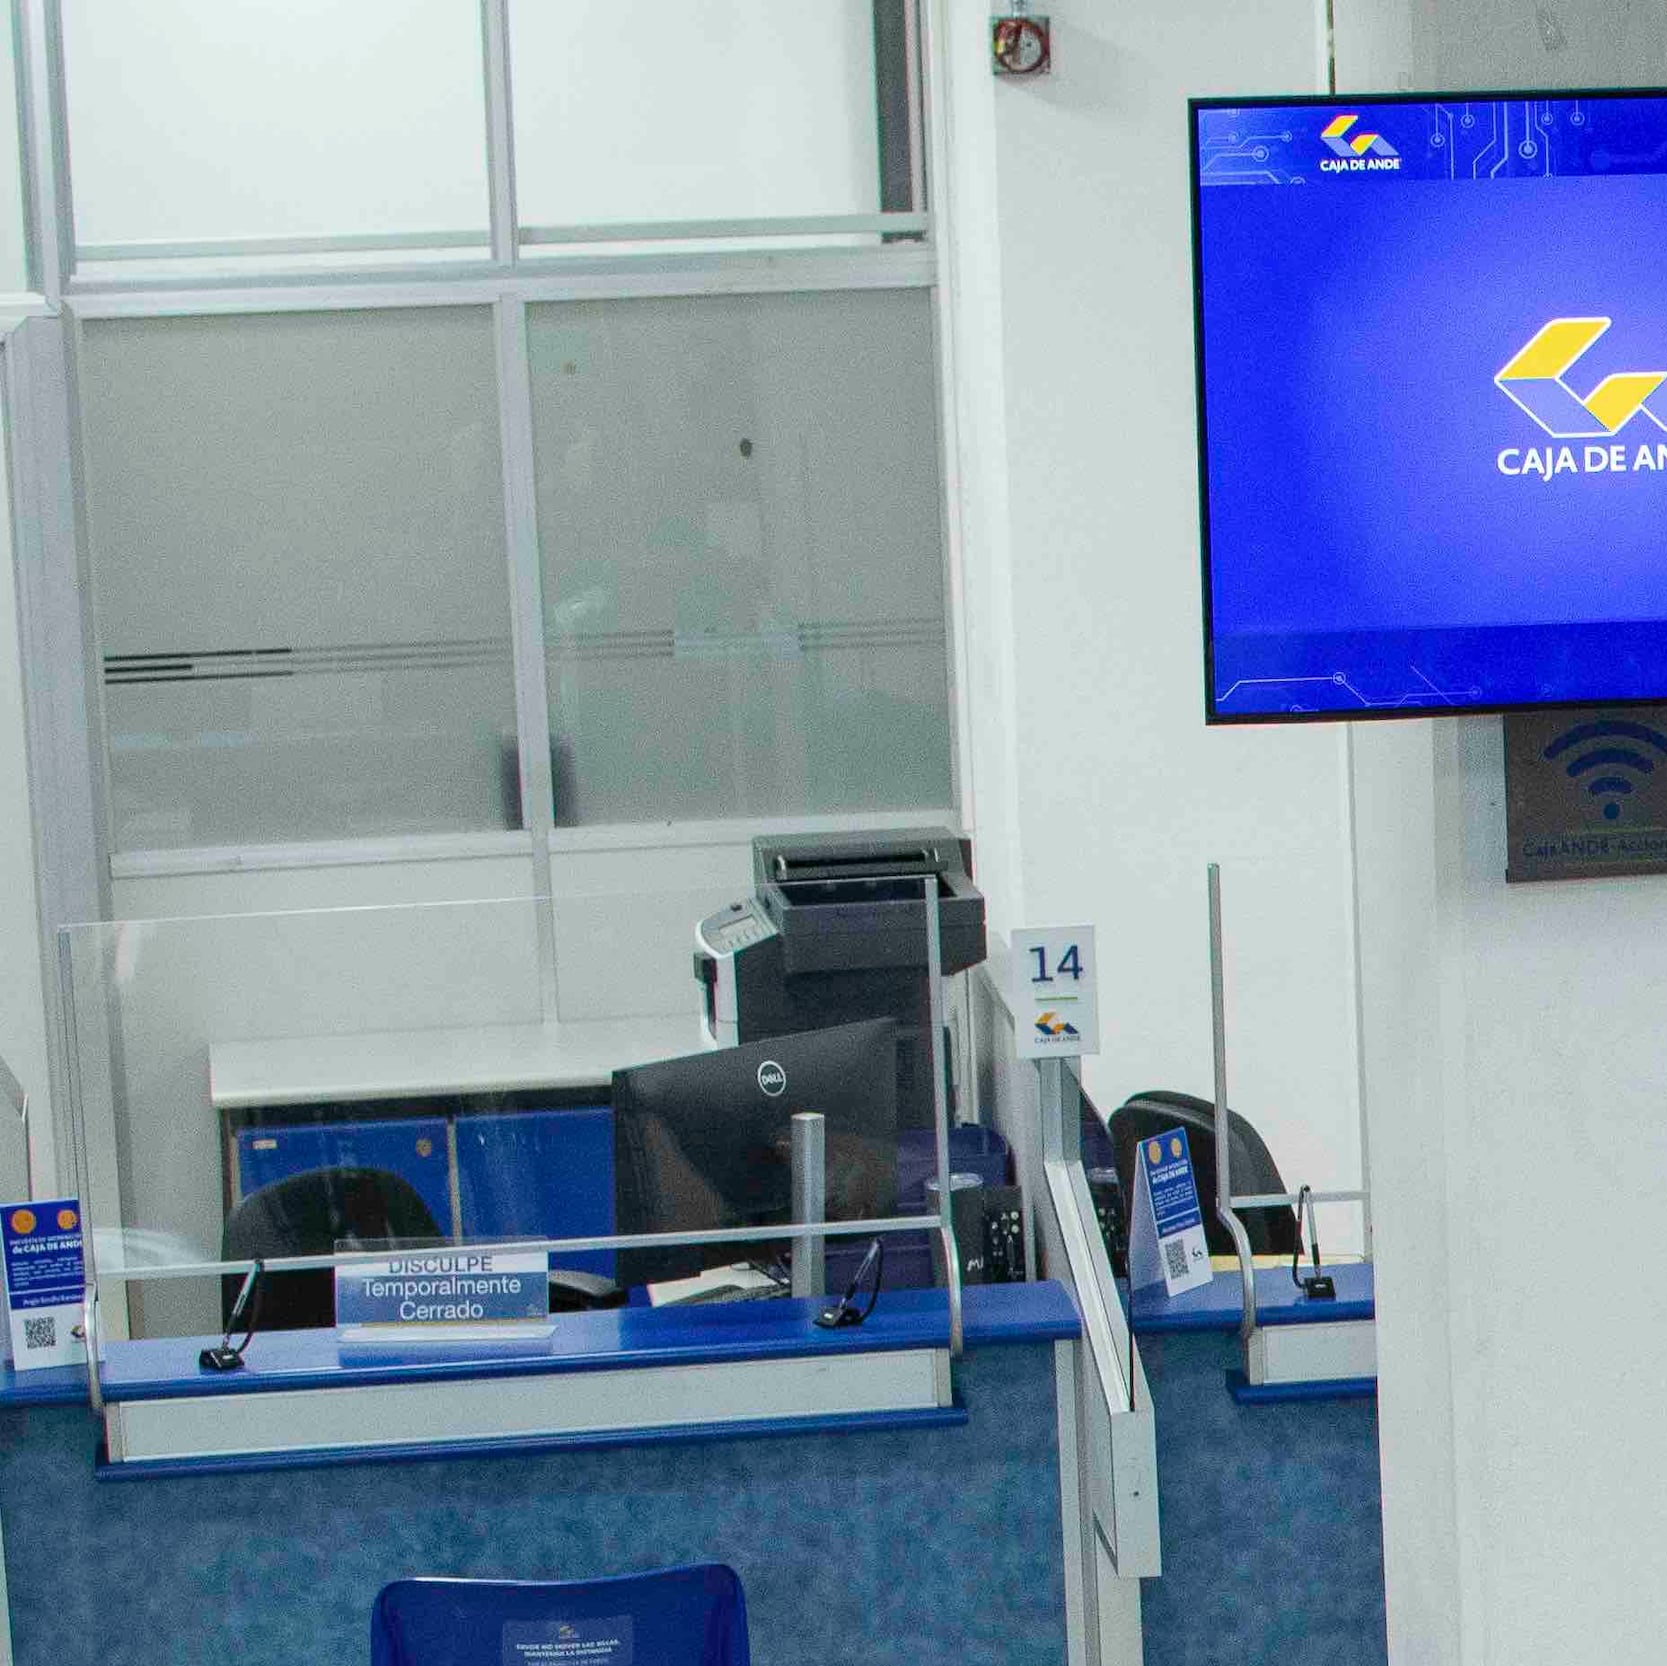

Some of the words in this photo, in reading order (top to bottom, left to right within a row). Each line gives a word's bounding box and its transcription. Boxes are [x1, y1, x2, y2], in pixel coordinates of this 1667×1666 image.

[1320, 159, 1349, 174] CAJA
[1350, 159, 1366, 171] DE
[1367, 158, 1400, 170] ANDE
[1497, 446, 1579, 482] CAJA
[1583, 444, 1627, 473] DE
[1029, 944, 1083, 982] 14
[389, 1255, 493, 1274] DISCULPE
[362, 1277, 522, 1301] Temporalmente
[400, 1301, 484, 1321] Cerrado
